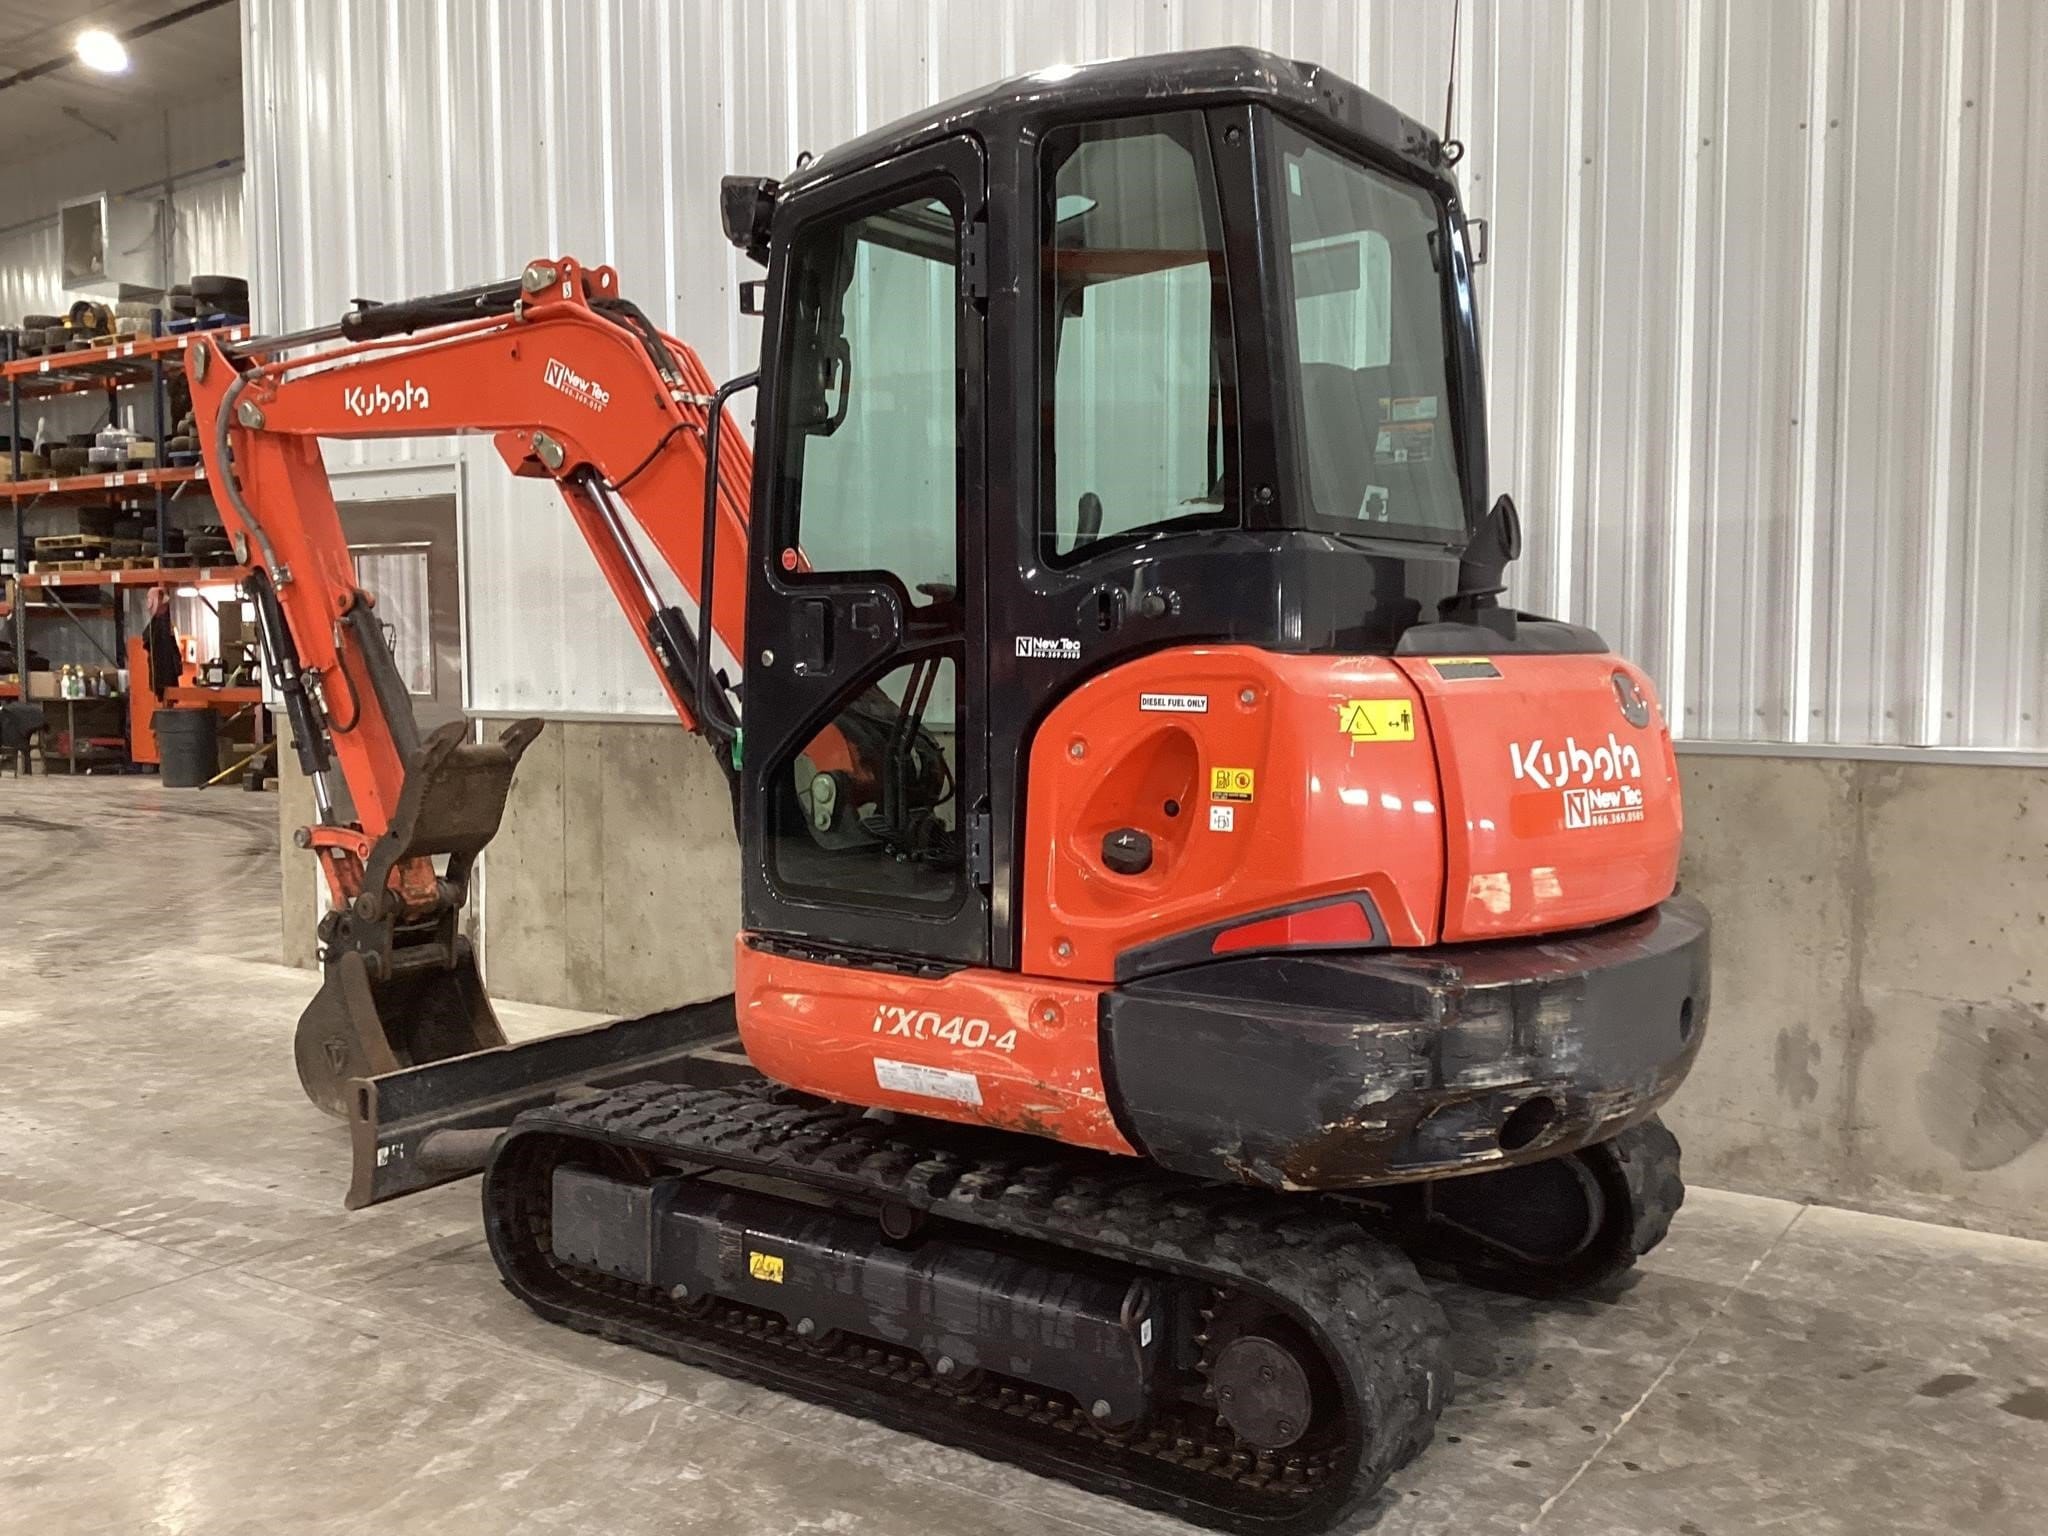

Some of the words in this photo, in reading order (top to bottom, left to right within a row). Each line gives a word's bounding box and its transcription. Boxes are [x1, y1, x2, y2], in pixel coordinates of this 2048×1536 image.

[563, 367, 590, 392] New
[344, 379, 429, 417] Kubota
[1033, 637, 1059, 650] New
[1142, 697, 1166, 707] DIESEL
[1167, 698, 1185, 708] FUEL
[1187, 698, 1206, 708] ONLY
[1509, 732, 1641, 790] Kubota
[1588, 788, 1621, 810] New
[1620, 785, 1643, 806] Tec
